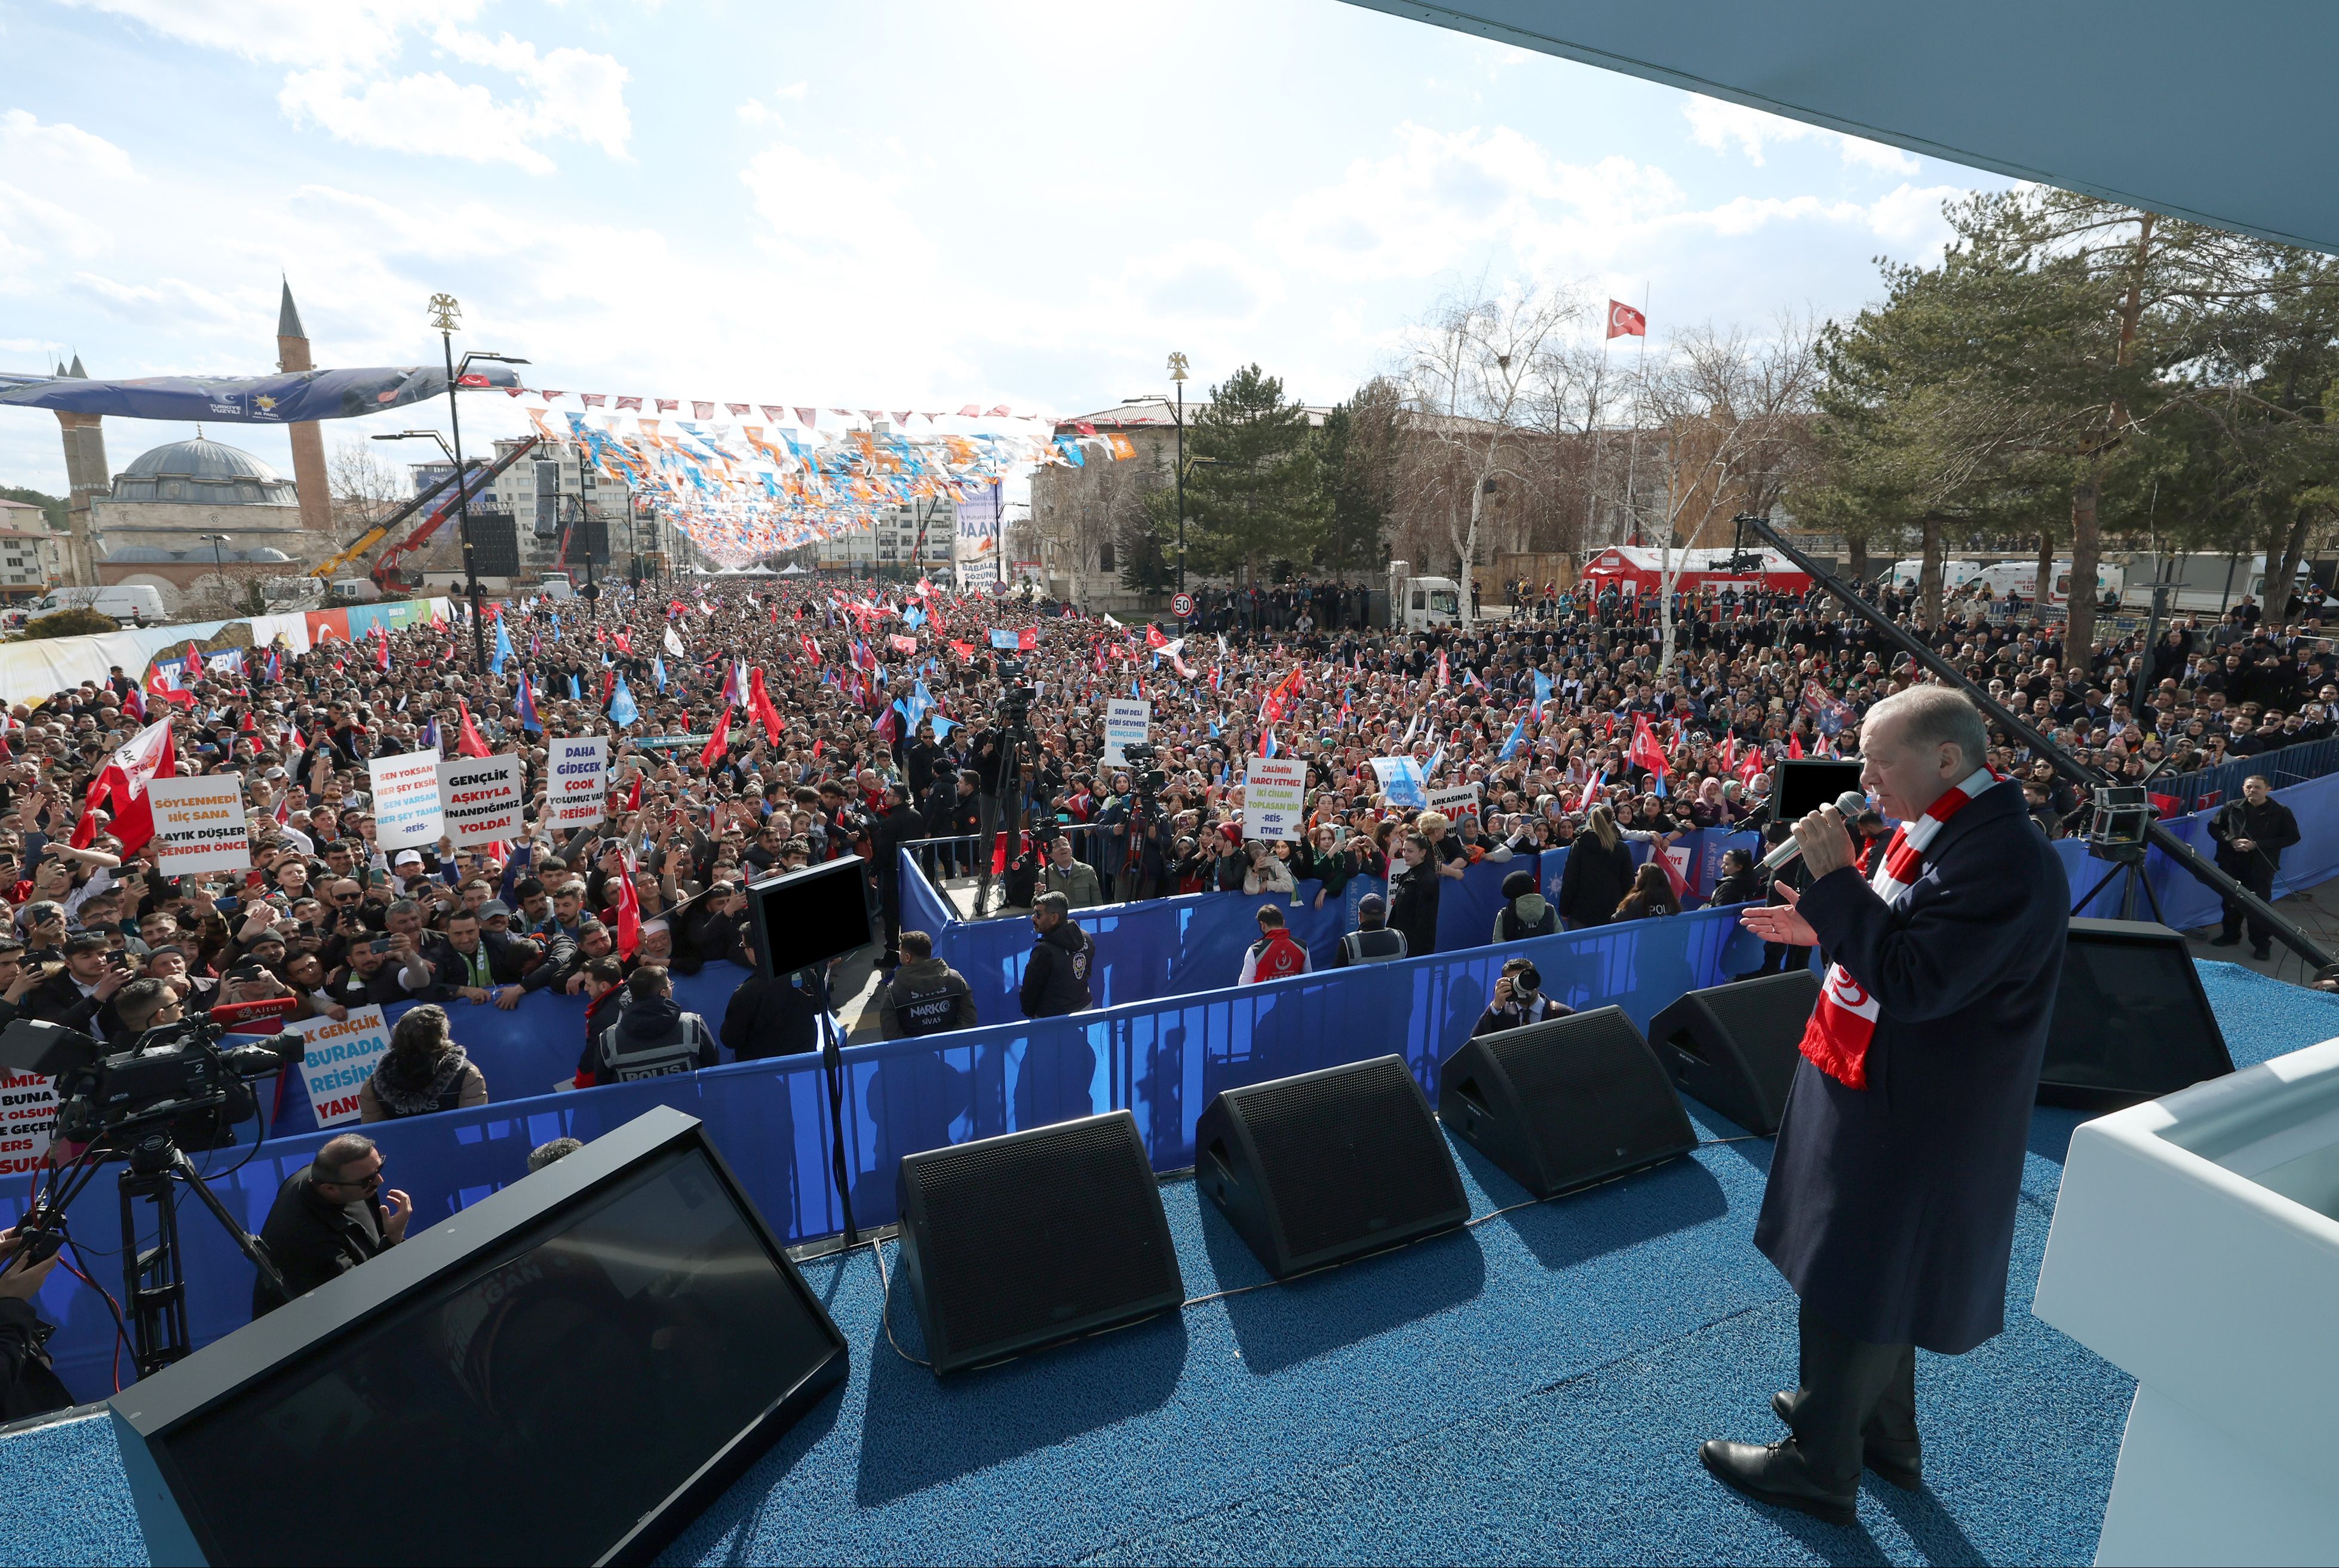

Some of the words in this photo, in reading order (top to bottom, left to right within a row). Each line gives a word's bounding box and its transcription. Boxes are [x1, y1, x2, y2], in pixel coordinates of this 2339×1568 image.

[1175, 600, 1189, 610] 50
[1110, 730, 1143, 738] GENÇLERİN
[566, 746, 596, 757] DAHA
[380, 772, 397, 781] SEN
[398, 765, 433, 778] YOKSAN
[557, 762, 601, 775] GİDECEK
[1262, 765, 1292, 774] ZALİMİN
[449, 769, 508, 786] GENÇLİK
[1273, 778, 1301, 787] YETMEZ
[377, 787, 395, 796] HER
[397, 783, 412, 794] ŞEY
[414, 778, 437, 788] EKSİK
[564, 779, 595, 793] ÇOOK
[451, 787, 511, 805] AŞKIYLA
[550, 794, 590, 805] YOLUMUZ
[591, 792, 603, 800] VAR
[1257, 788, 1267, 797] İKİ
[1268, 788, 1293, 798] CİHANI
[1432, 793, 1473, 806] ARKASINDA
[154, 793, 237, 809] SÖYLENMEDİ
[383, 800, 401, 809] SEN
[403, 793, 437, 805] VARSAN
[1248, 801, 1285, 810] TOPLASAN
[1287, 802, 1299, 811] BİR
[445, 799, 520, 818] İNANDIĞIMIZ
[560, 805, 597, 820] REİSİM
[168, 811, 190, 823] HİÇ
[193, 810, 229, 821] SANA
[377, 815, 395, 825] HER
[397, 812, 413, 823] ŞEY
[459, 816, 511, 834] YOLDA!
[198, 827, 245, 839] DÜŞLER
[159, 844, 210, 857] SENDEN
[214, 841, 247, 852] ÖNCE
[1709, 842, 1717, 853] AK
[255, 1004, 283, 1014] Altus
[319, 1014, 381, 1039] GENÇLİK
[922, 1017, 941, 1025] SİVAS
[304, 1036, 386, 1069] BURADA
[195, 1064, 204, 1073] 2
[2, 1091, 54, 1106] BUNA
[8, 1107, 58, 1120] OLSUN
[11, 1121, 59, 1135] GEÇEN
[0, 1139, 33, 1152] ERS
